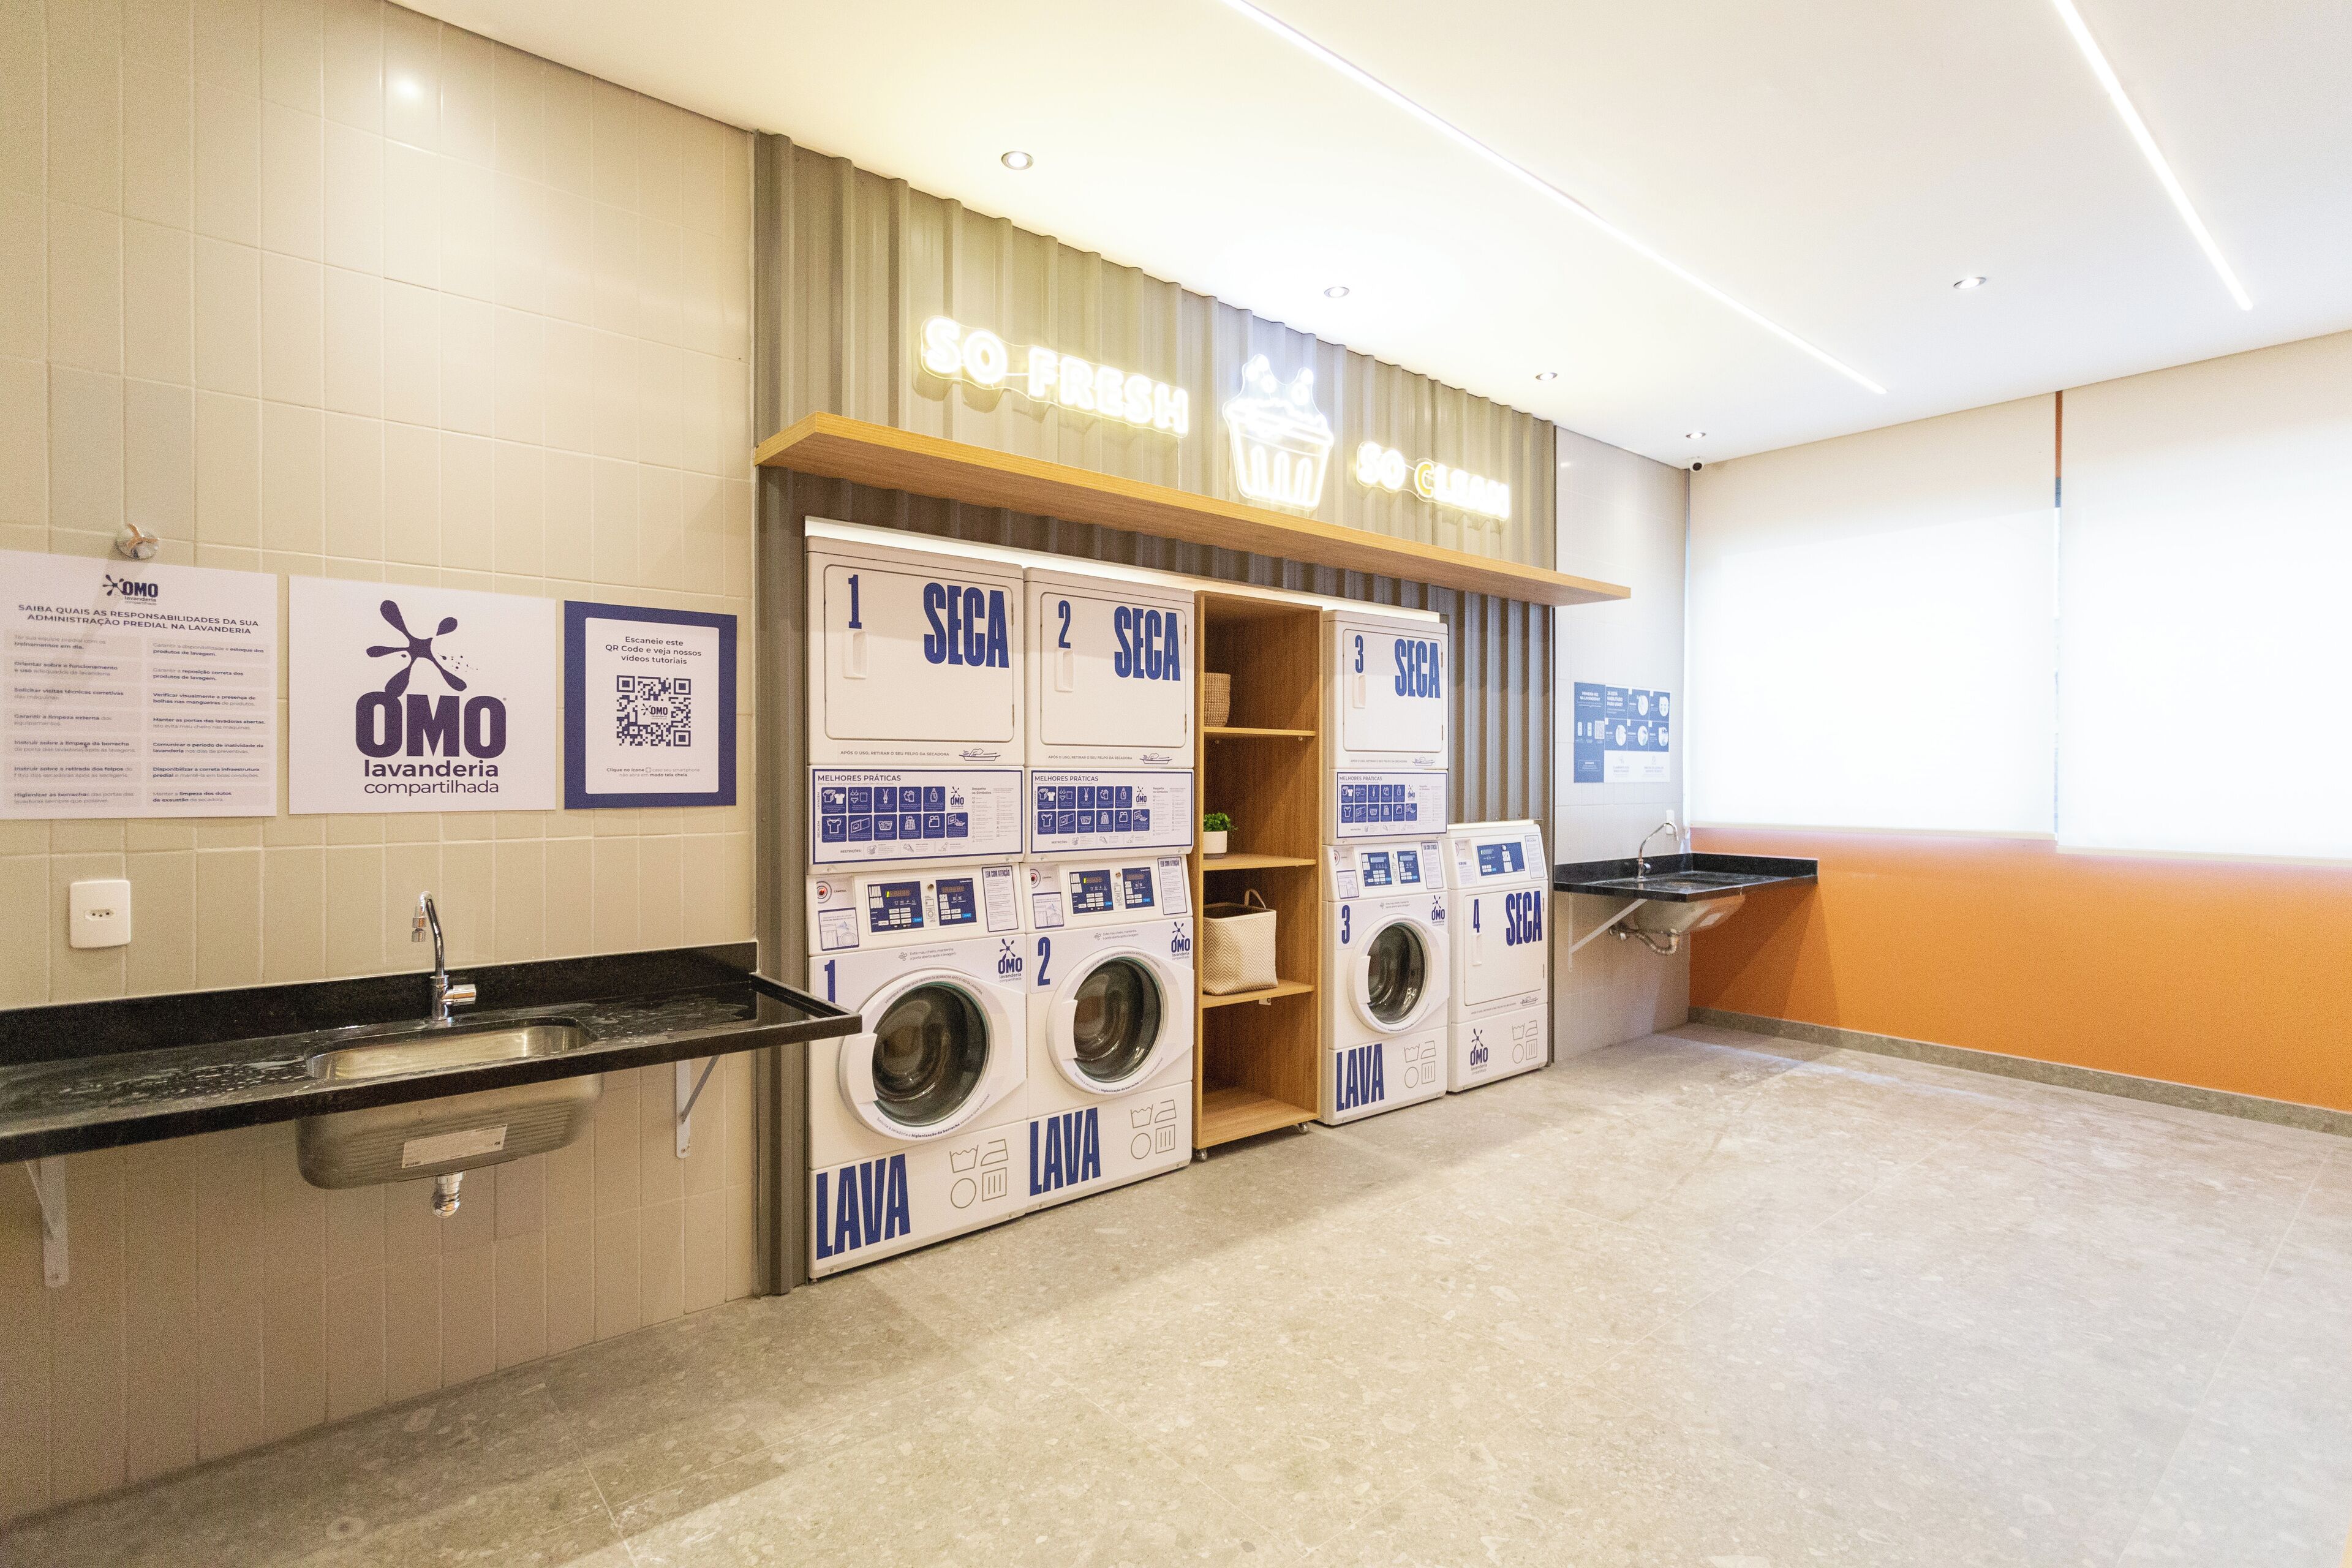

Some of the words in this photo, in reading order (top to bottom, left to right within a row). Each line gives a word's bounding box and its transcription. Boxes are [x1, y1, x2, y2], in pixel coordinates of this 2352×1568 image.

[926, 317, 1008, 385] SO
[1028, 346, 1189, 434] FRESH
[1359, 442, 1406, 490] SO
[123, 581, 159, 597] OMO
[18, 604, 53, 612] SAIBA
[56, 607, 90, 616] QUAIS
[110, 611, 220, 624] RESPONSABILIDADES
[28, 614, 120, 627] ADMINISTRAÇÃO
[124, 620, 168, 629] PREDIAL
[189, 625, 251, 634] LAVANDERIA
[848, 574, 862, 629] 1
[923, 582, 1009, 668] SECA
[1058, 600, 1071, 649] 2
[1114, 606, 1181, 681] SECA
[1355, 635, 1363, 673] 3
[1395, 638, 1441, 699] SECA
[356, 692, 506, 758] OMO
[364, 780, 499, 796] compartilhada
[365, 760, 498, 777] lavanderia
[998, 869, 1009, 878] ATENÇÃO
[1341, 904, 1350, 944] 3
[1431, 909, 1445, 921] OMO
[1473, 899, 1480, 933] 4
[1506, 891, 1542, 946] SECA
[998, 957, 1023, 974] OMO
[1037, 937, 1051, 986] 2
[1171, 938, 1191, 953] OMO
[824, 959, 835, 1003] 1
[1336, 1043, 1385, 1112] LAVA
[1470, 1047, 1488, 1066] OMO
[943, 1123, 960, 1133] borracha
[1030, 1107, 1101, 1197] LAVA
[816, 1153, 911, 1260] LAVA
